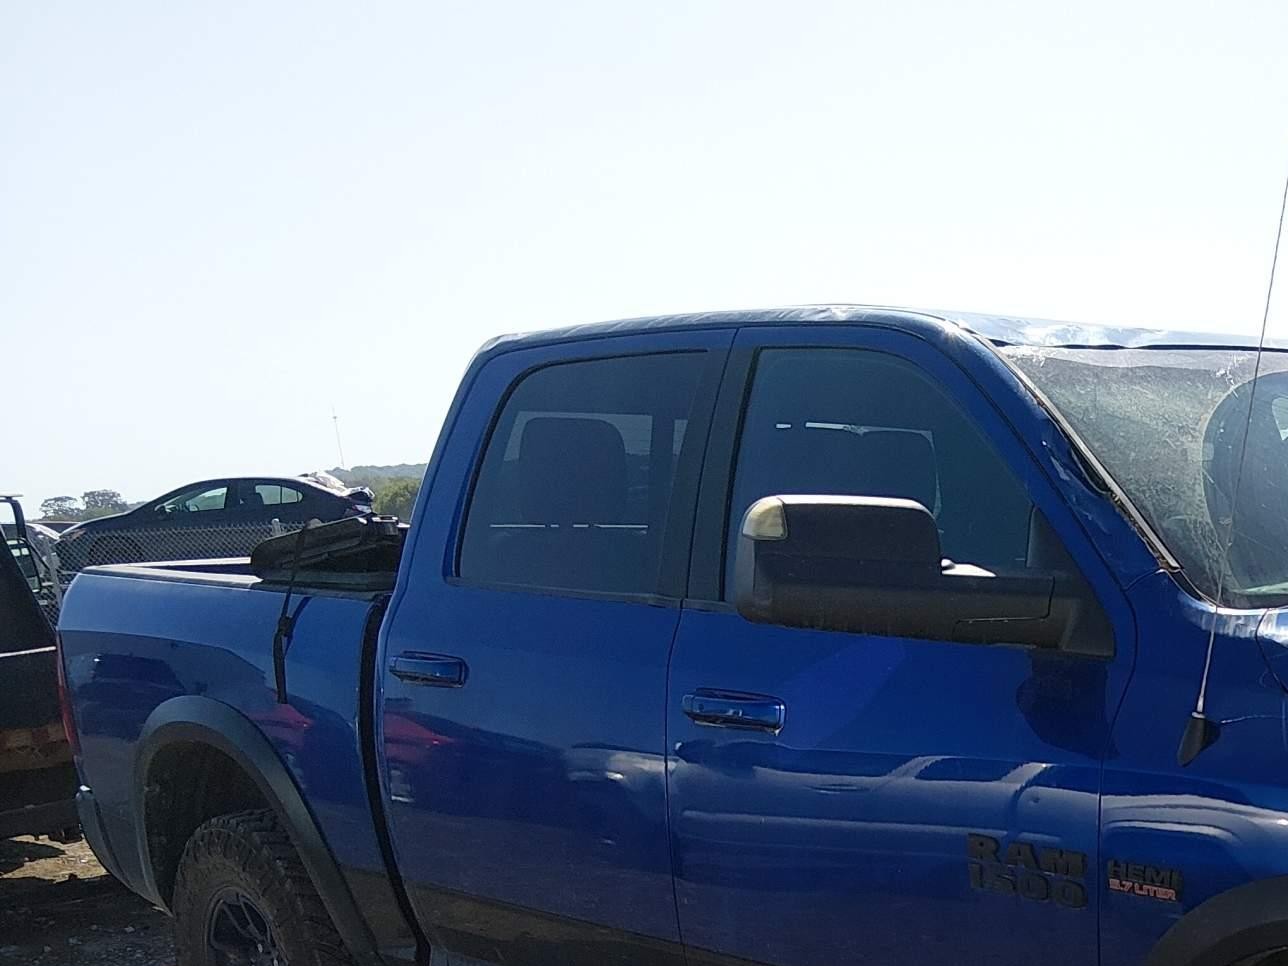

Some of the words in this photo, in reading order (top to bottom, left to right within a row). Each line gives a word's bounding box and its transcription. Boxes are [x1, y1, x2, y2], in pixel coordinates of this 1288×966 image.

[967, 832, 1088, 878] RAM
[1107, 859, 1182, 887] HEMI
[968, 862, 1089, 909] 1500
[1134, 883, 1177, 901] LITER
